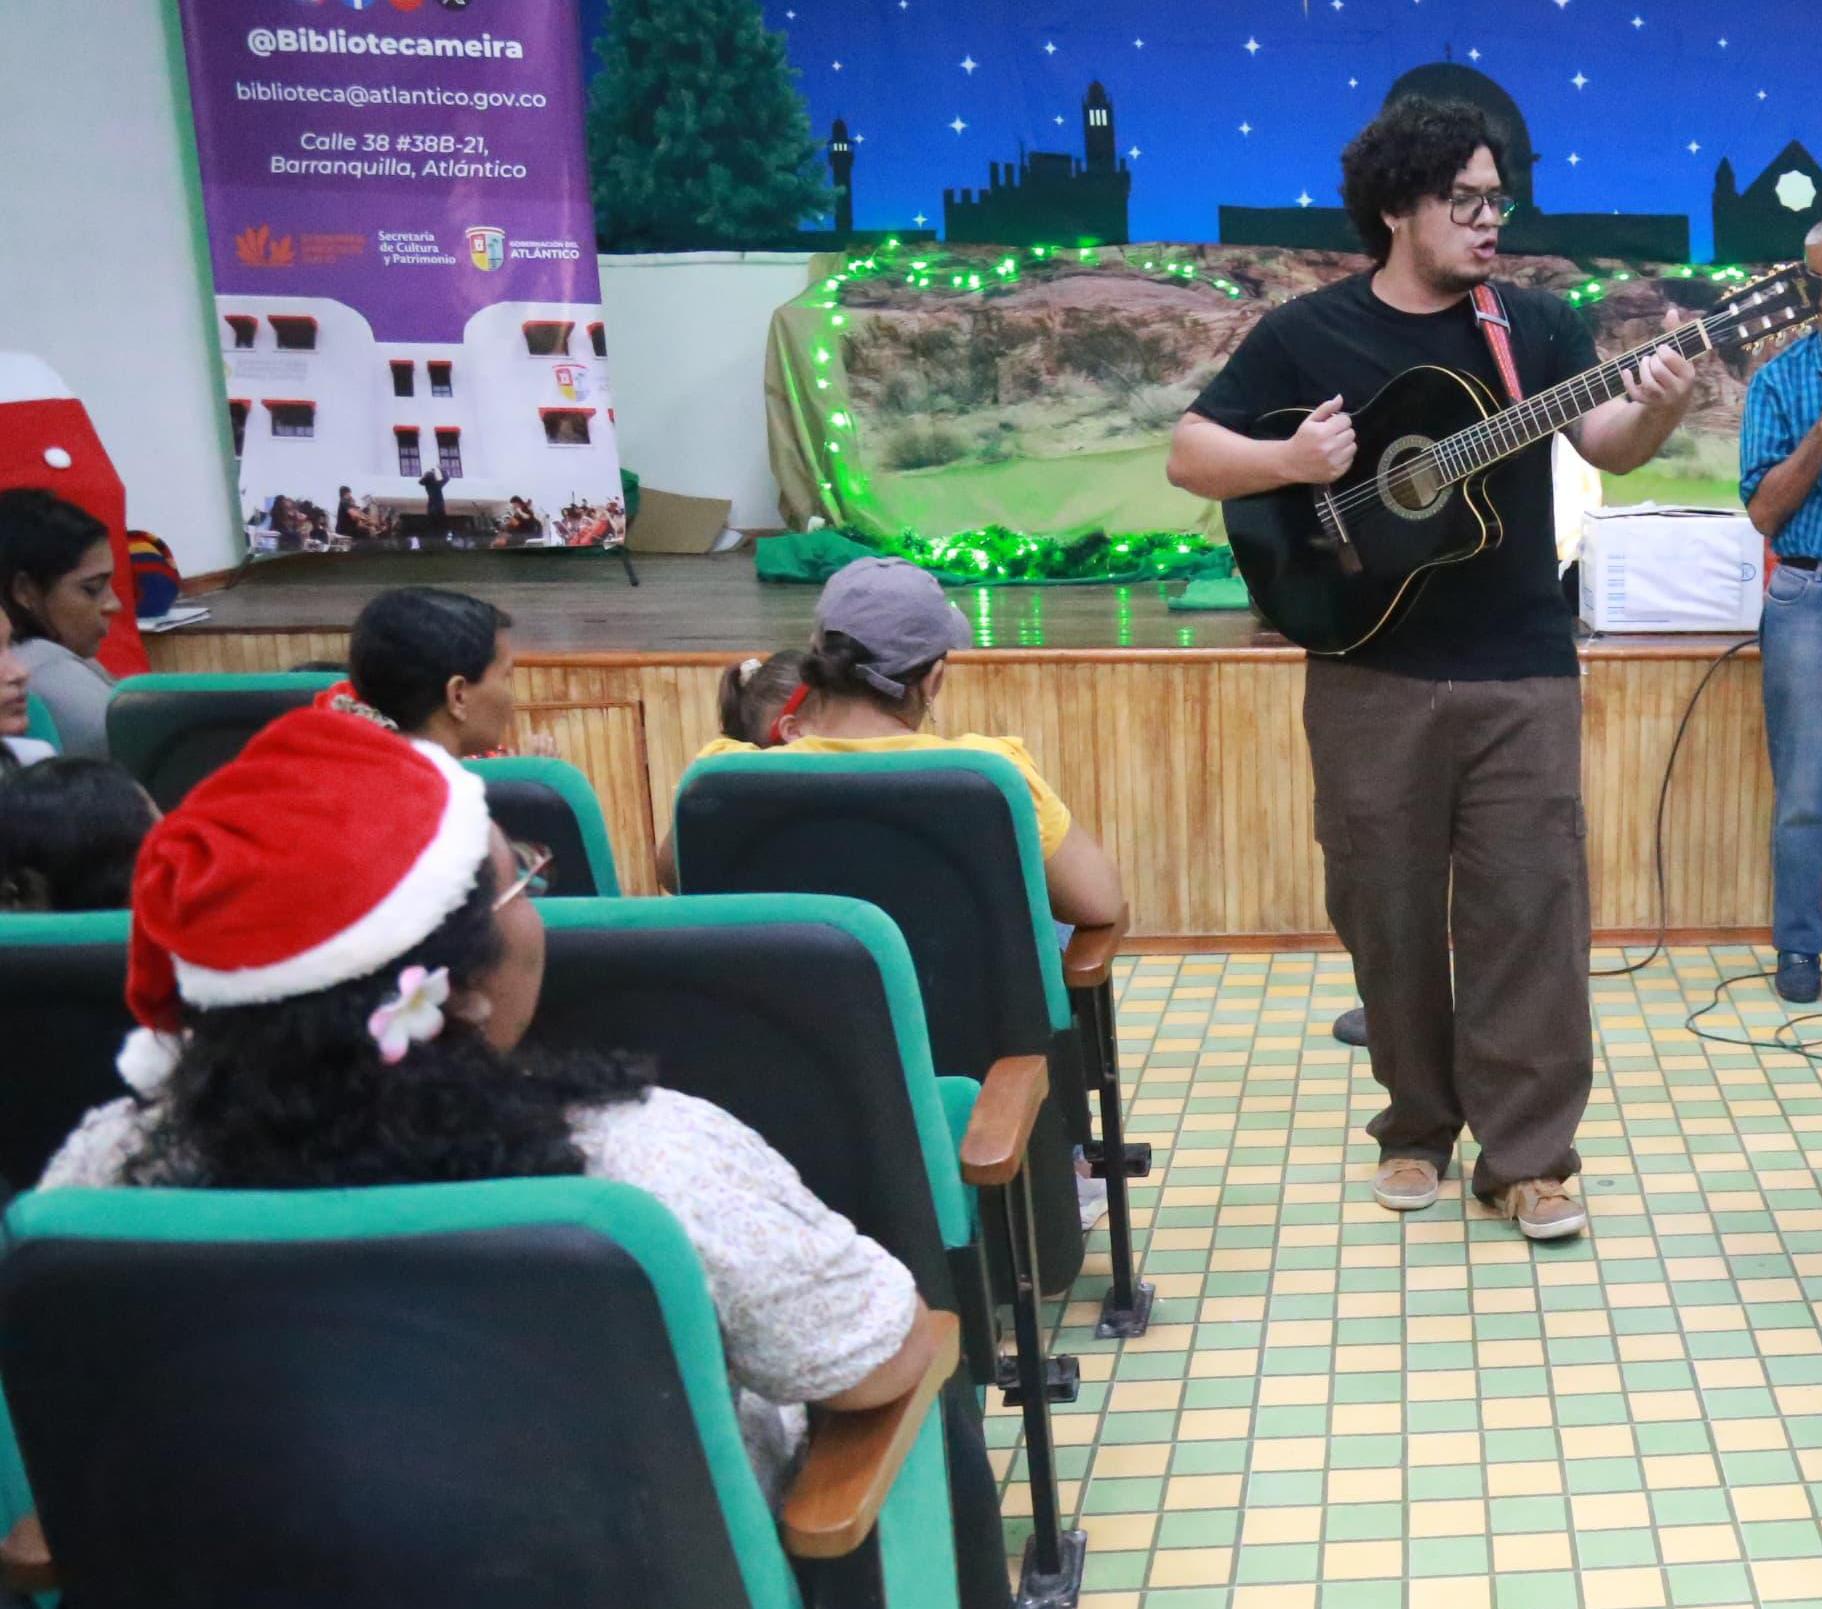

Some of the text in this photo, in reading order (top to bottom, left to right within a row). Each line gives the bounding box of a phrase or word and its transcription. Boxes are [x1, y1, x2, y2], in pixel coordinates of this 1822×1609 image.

[247, 27, 524, 60] @Bibliotecameira
[235, 81, 547, 109] biblioteca@atlantico.gov.co
[300, 132, 489, 157] Calle 38 #38B-21,
[270, 156, 528, 180] Barranquilla, Atlántico
[380, 242, 440, 254] de Cultura
[384, 254, 457, 266] y Patrimonio
[510, 248, 580, 260] ATLÁNTICO
